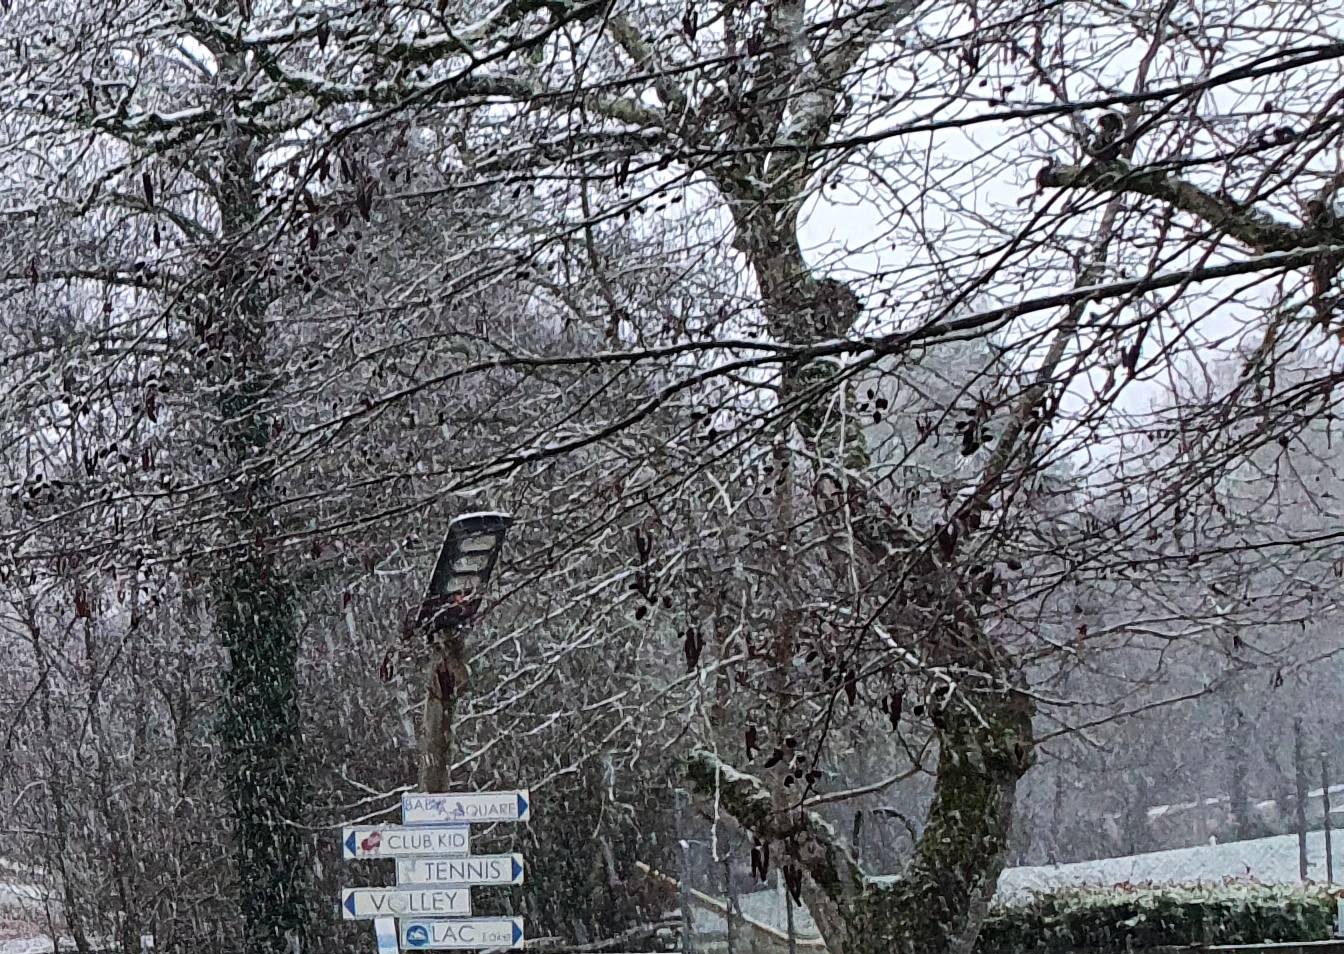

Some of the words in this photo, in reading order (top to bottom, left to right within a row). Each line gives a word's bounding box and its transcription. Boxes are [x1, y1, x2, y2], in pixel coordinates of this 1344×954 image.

[388, 834, 432, 850] CLUB
[438, 833, 465, 848] KID
[424, 860, 501, 881] TENNIS
[370, 891, 458, 912] VOLLEY
[432, 925, 475, 943] LAC
